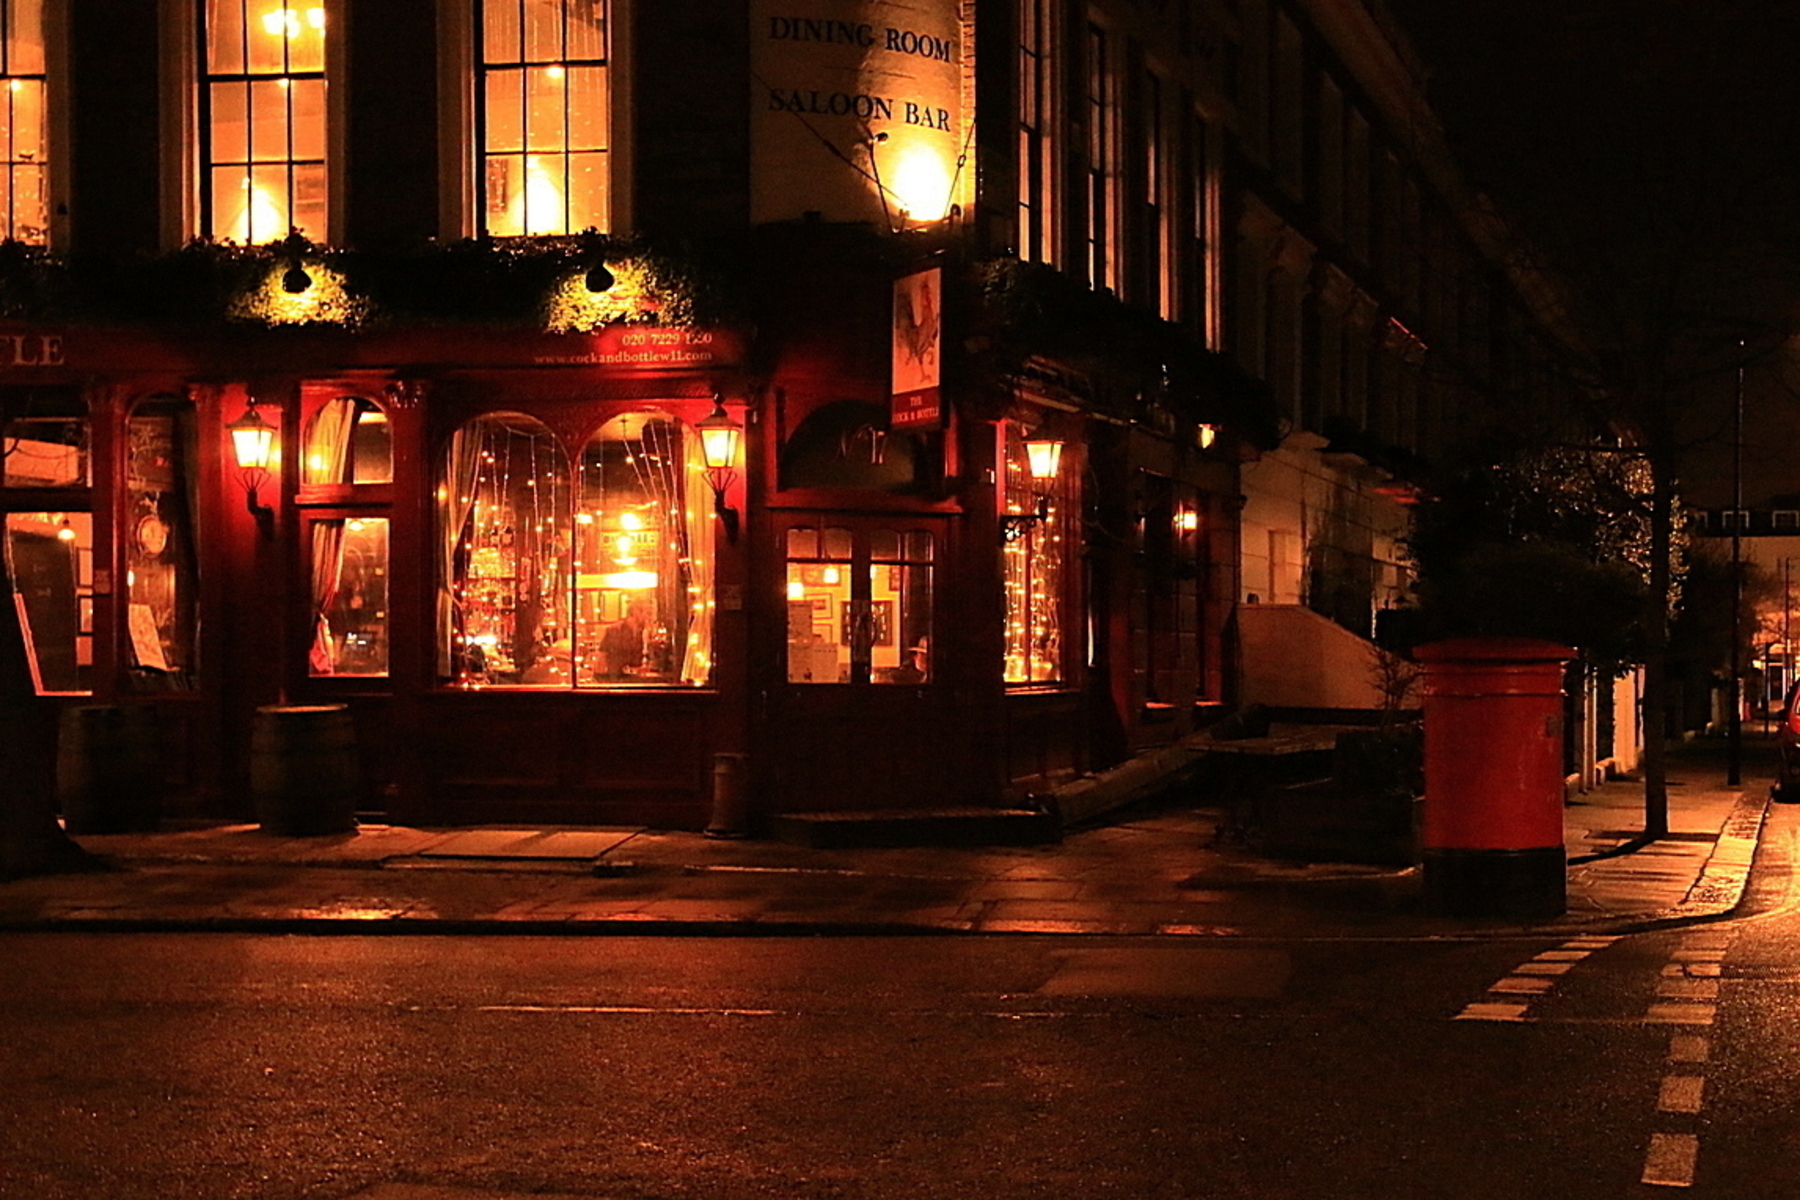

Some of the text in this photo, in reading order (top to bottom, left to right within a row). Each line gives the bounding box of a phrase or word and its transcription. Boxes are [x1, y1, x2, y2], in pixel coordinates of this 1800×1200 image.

[770, 17, 950, 62] DINING ROOM
[768, 87, 951, 132] SALOON BAR
[622, 333, 645, 346] 020
[651, 333, 681, 346] 7229
